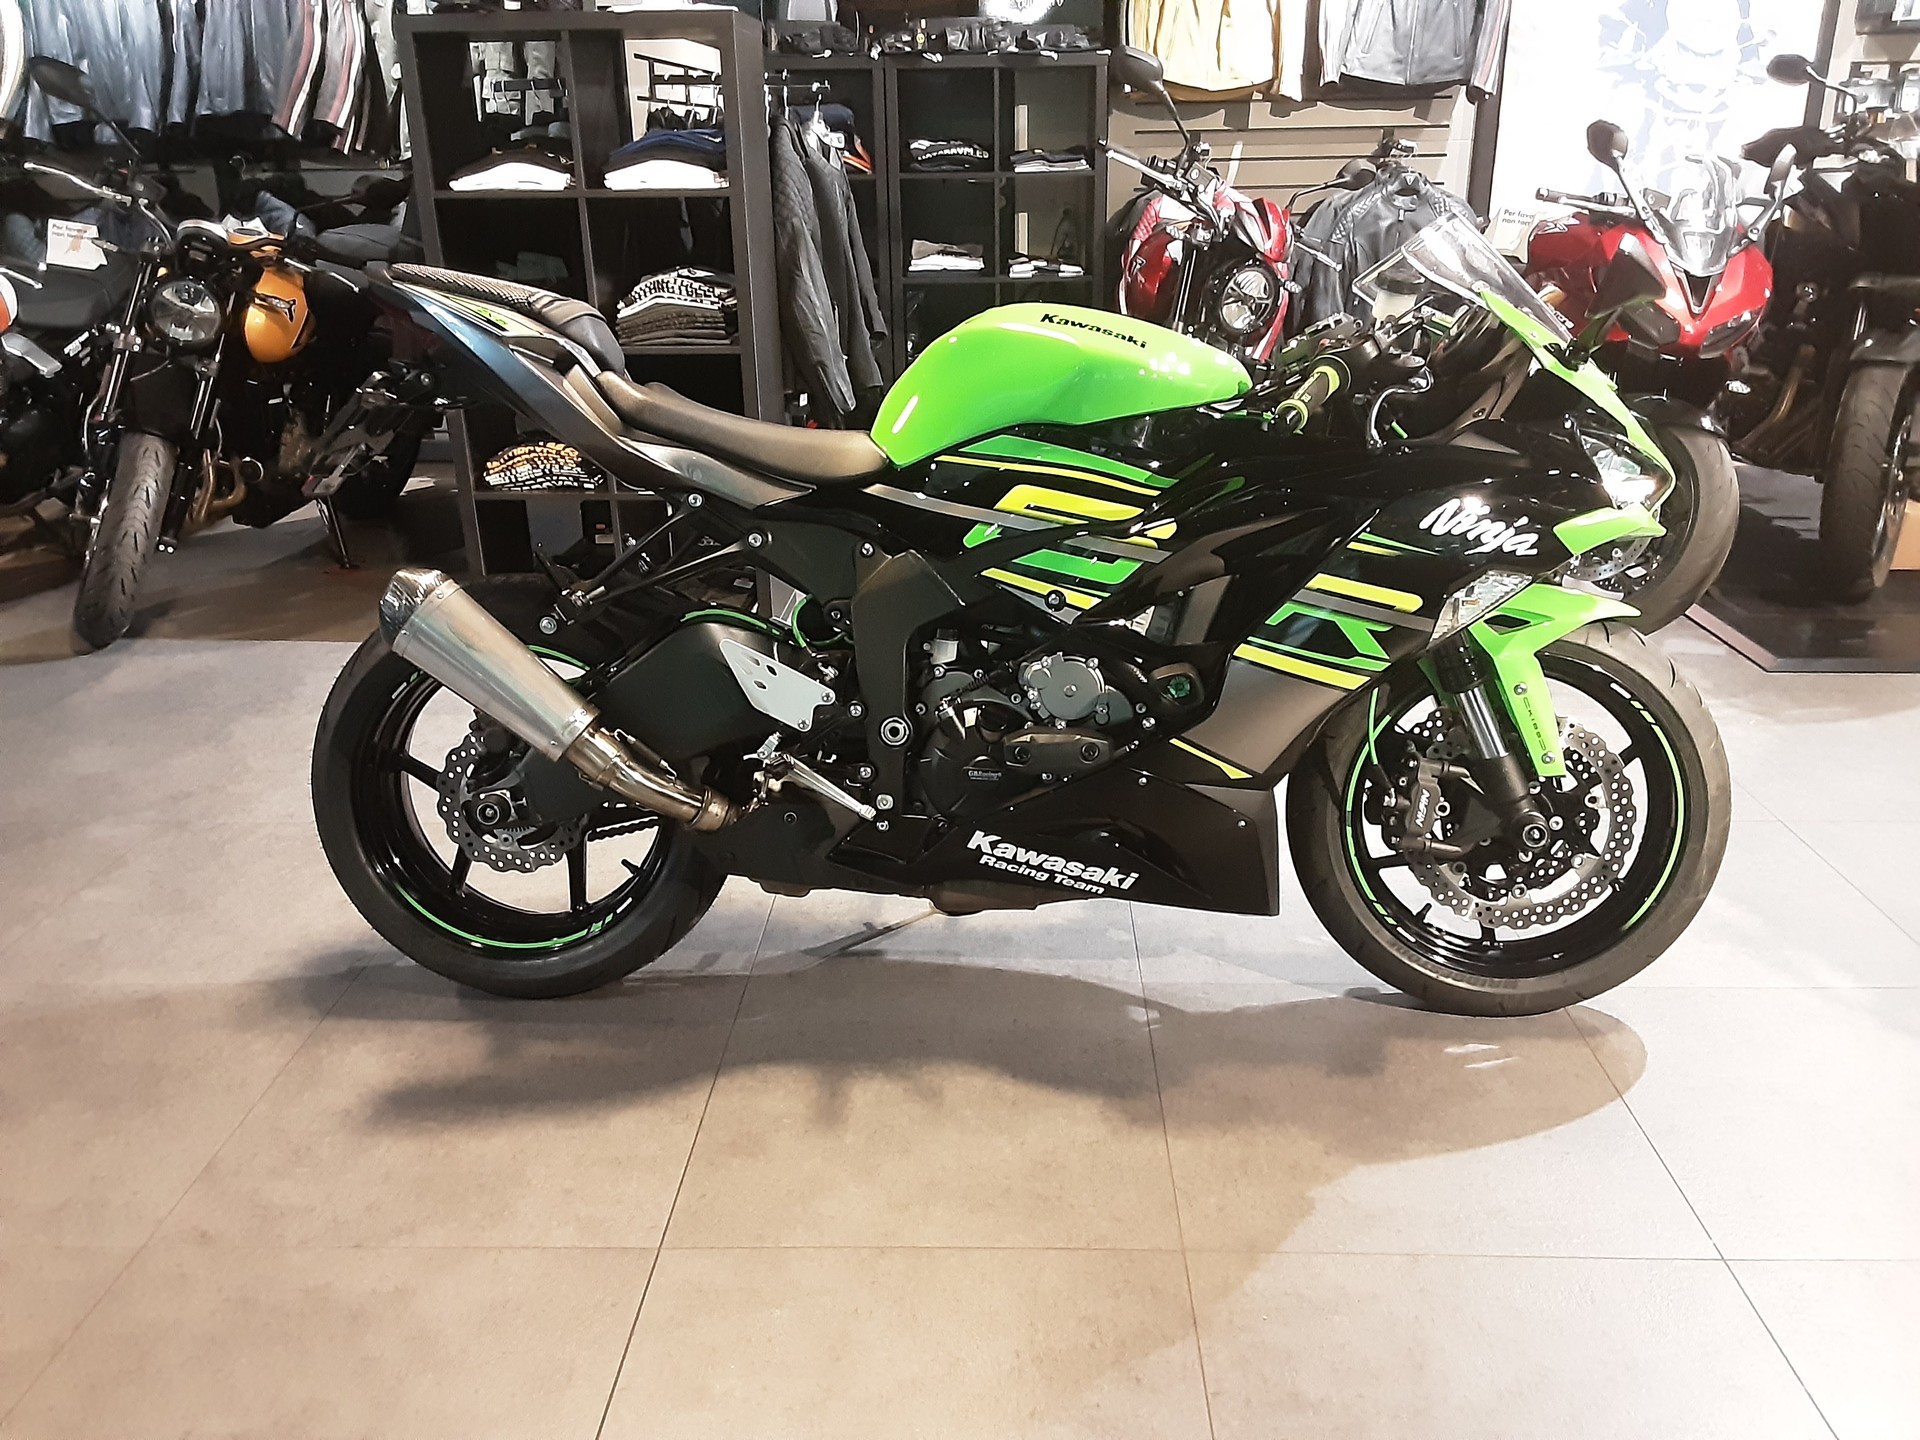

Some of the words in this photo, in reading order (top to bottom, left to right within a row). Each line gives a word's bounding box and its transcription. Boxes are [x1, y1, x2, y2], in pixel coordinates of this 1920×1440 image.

[1504, 209, 1515, 217] Per
[1518, 211, 1534, 219] favo
[1040, 313, 1147, 349] Kawasaki
[1418, 497, 1539, 556] Ninja
[966, 829, 1140, 891] Kawasaki
[979, 854, 1050, 882] Racing
[1053, 873, 1106, 895] Team
